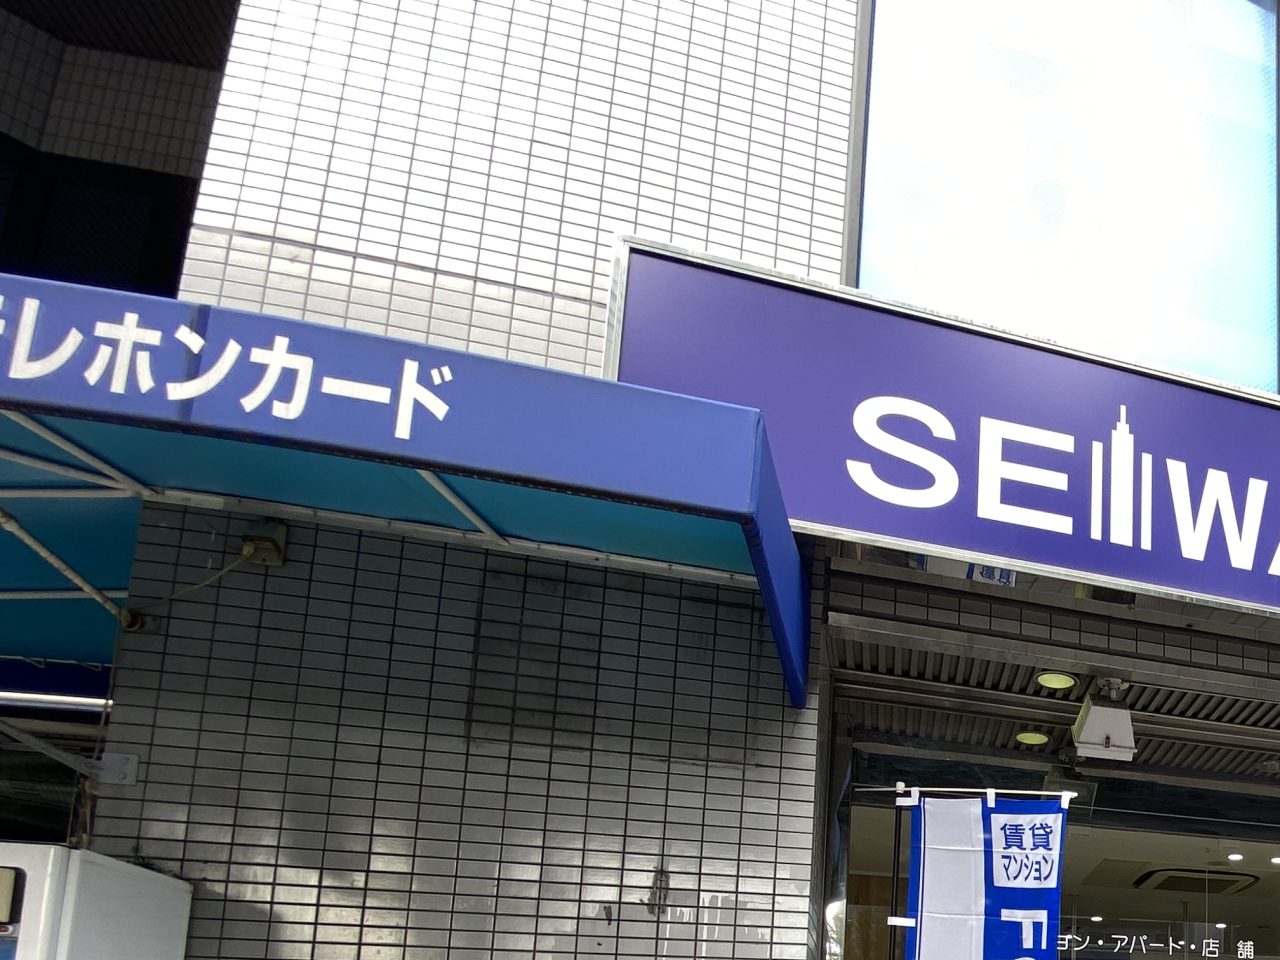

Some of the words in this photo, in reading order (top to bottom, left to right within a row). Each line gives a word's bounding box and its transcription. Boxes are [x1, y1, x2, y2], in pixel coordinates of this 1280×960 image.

[0, 295, 452, 439] レホンカード
[1000, 823, 1053, 851] 賃貸
[1001, 854, 1054, 881] マンション
